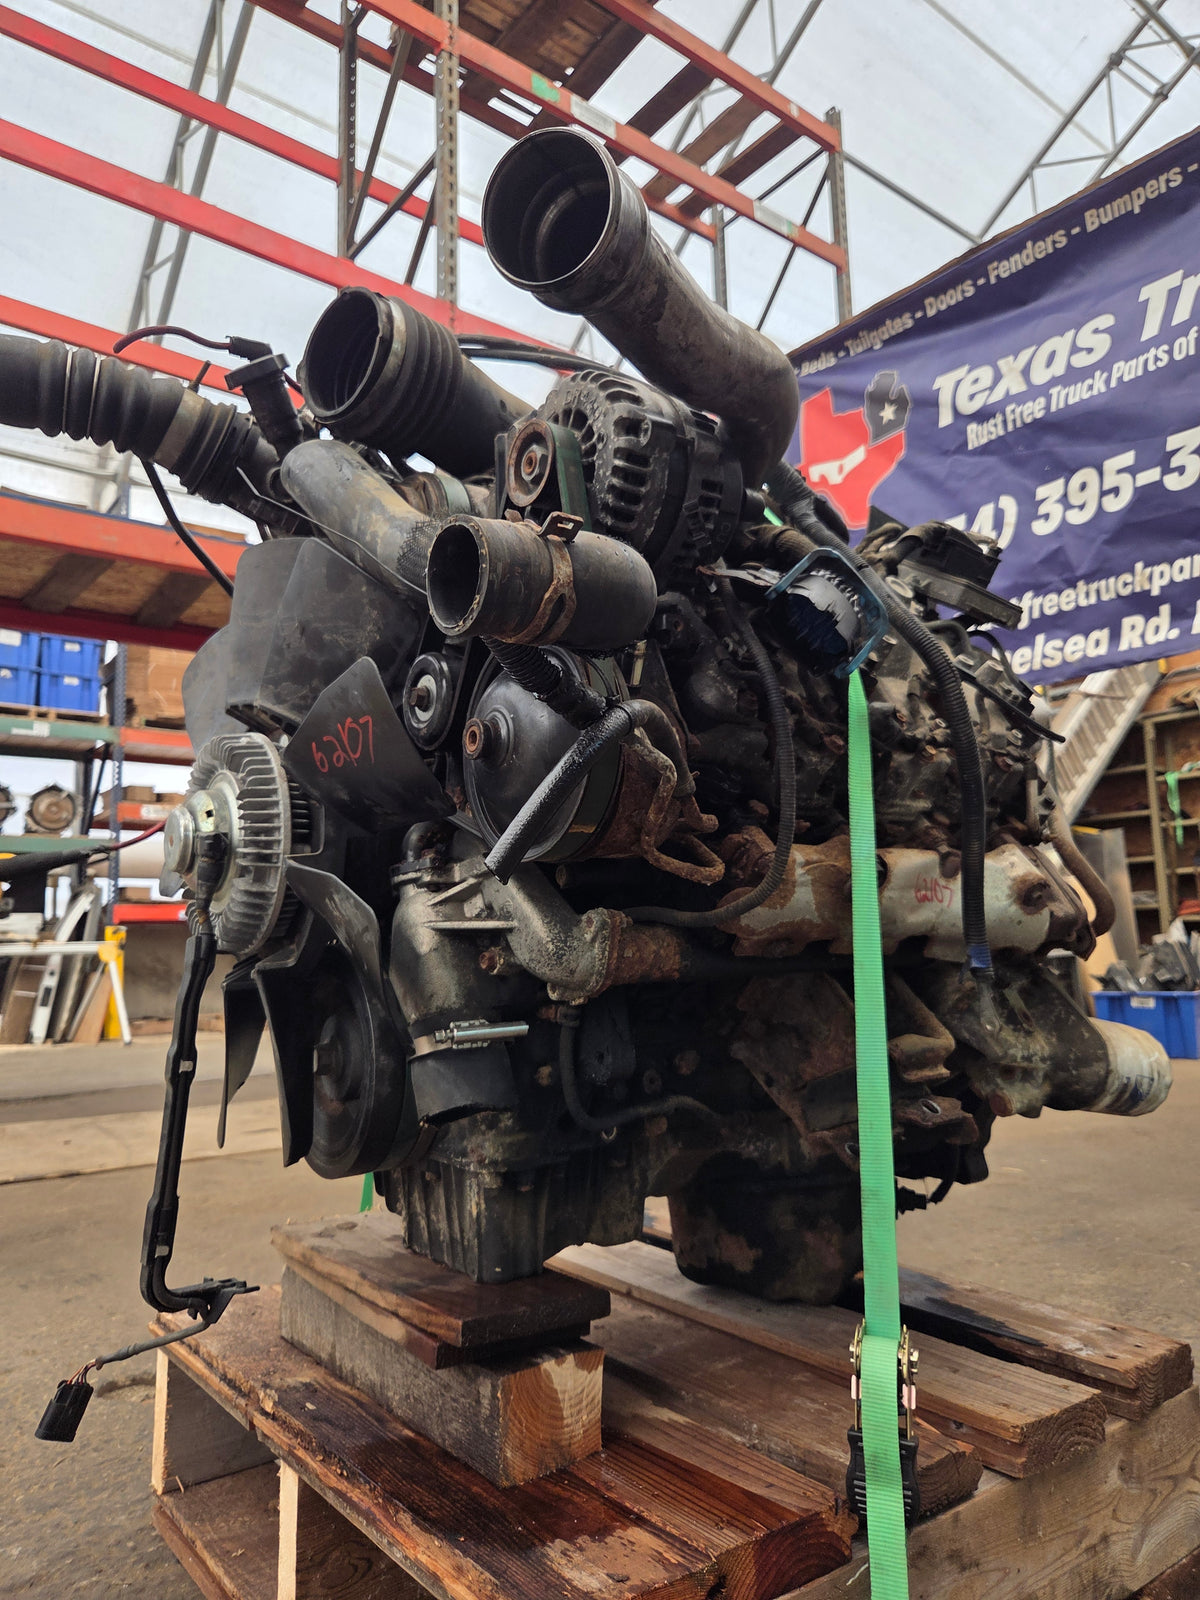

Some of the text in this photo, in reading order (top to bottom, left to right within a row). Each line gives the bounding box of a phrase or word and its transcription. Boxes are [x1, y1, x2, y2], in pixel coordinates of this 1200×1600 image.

[844, 312, 915, 357] Tailgates
[924, 280, 976, 318] Doors
[987, 229, 1068, 285] Fenders
[1084, 166, 1183, 233] Bumpers
[932, 269, 1200, 428] Texas Tr
[966, 326, 1199, 450] Rust Free Truck Parts of
[1031, 426, 1200, 536] 395-3
[966, 553, 1200, 632] freetruckpar
[1118, 602, 1180, 650] Rd.
[311, 715, 374, 773] 62107
